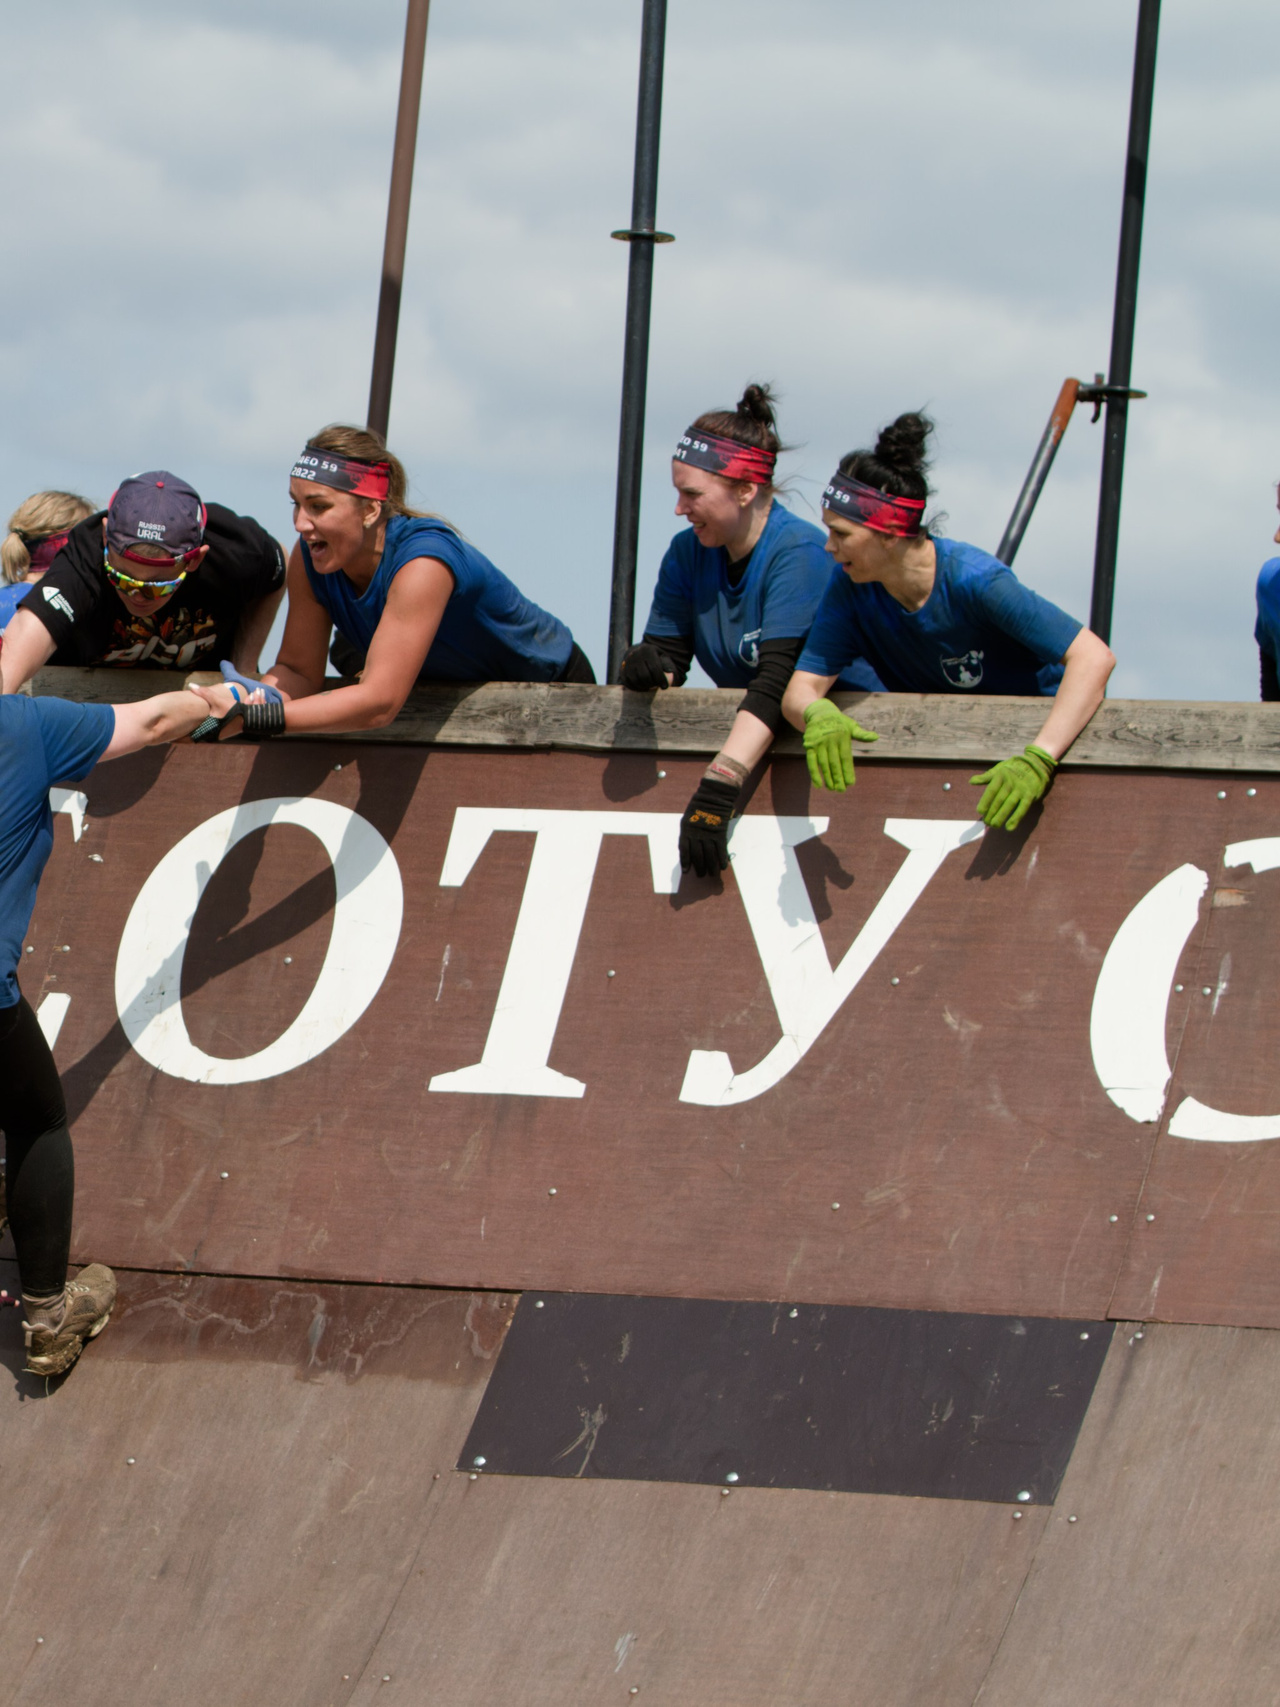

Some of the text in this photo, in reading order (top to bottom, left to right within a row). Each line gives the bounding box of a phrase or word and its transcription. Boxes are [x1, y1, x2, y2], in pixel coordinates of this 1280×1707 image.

[692, 440, 709, 452] 59
[320, 460, 338, 473] 59
[834, 489, 851, 504] 59
[138, 520, 166, 532] RUSSIA
[137, 528, 164, 541] URAL
